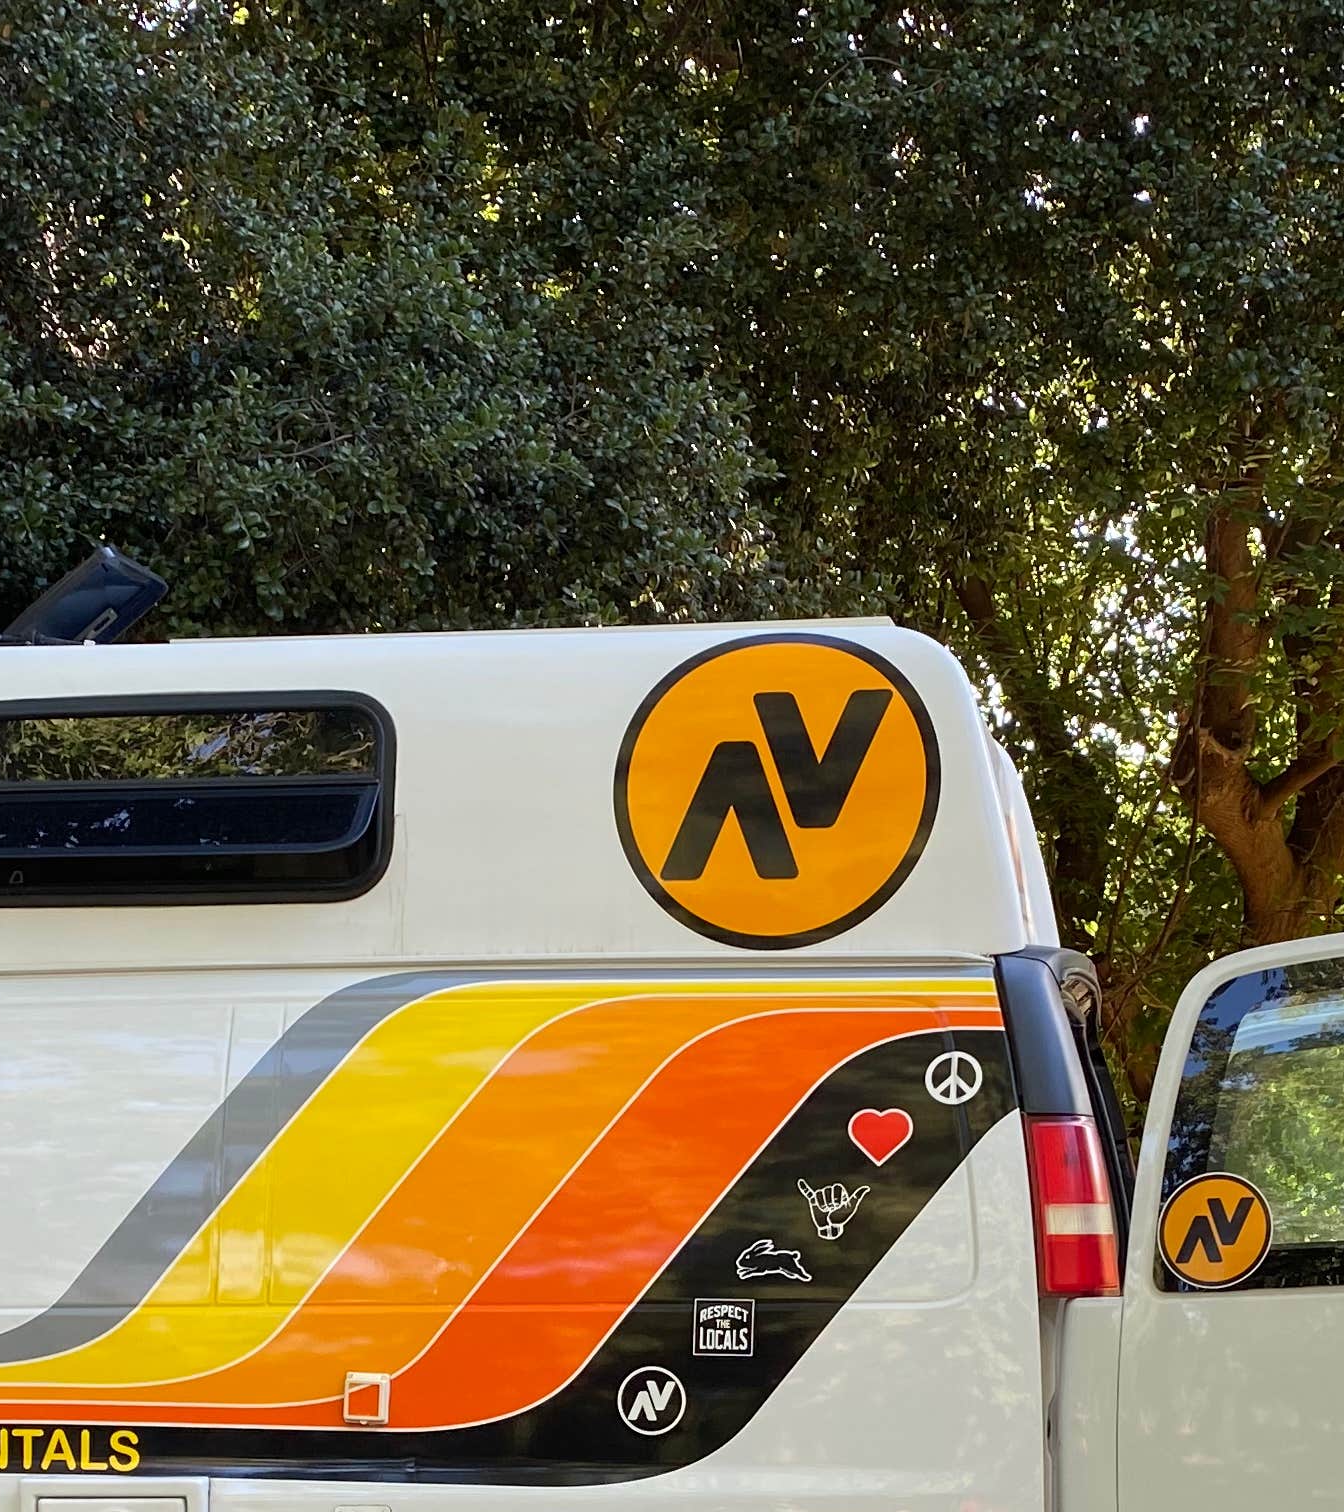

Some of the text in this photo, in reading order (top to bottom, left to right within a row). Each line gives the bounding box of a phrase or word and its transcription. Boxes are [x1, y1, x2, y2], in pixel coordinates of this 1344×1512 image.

[699, 1304, 749, 1323] RESPECT
[716, 1318, 731, 1329] THE
[699, 1326, 749, 1350] LOCALS
